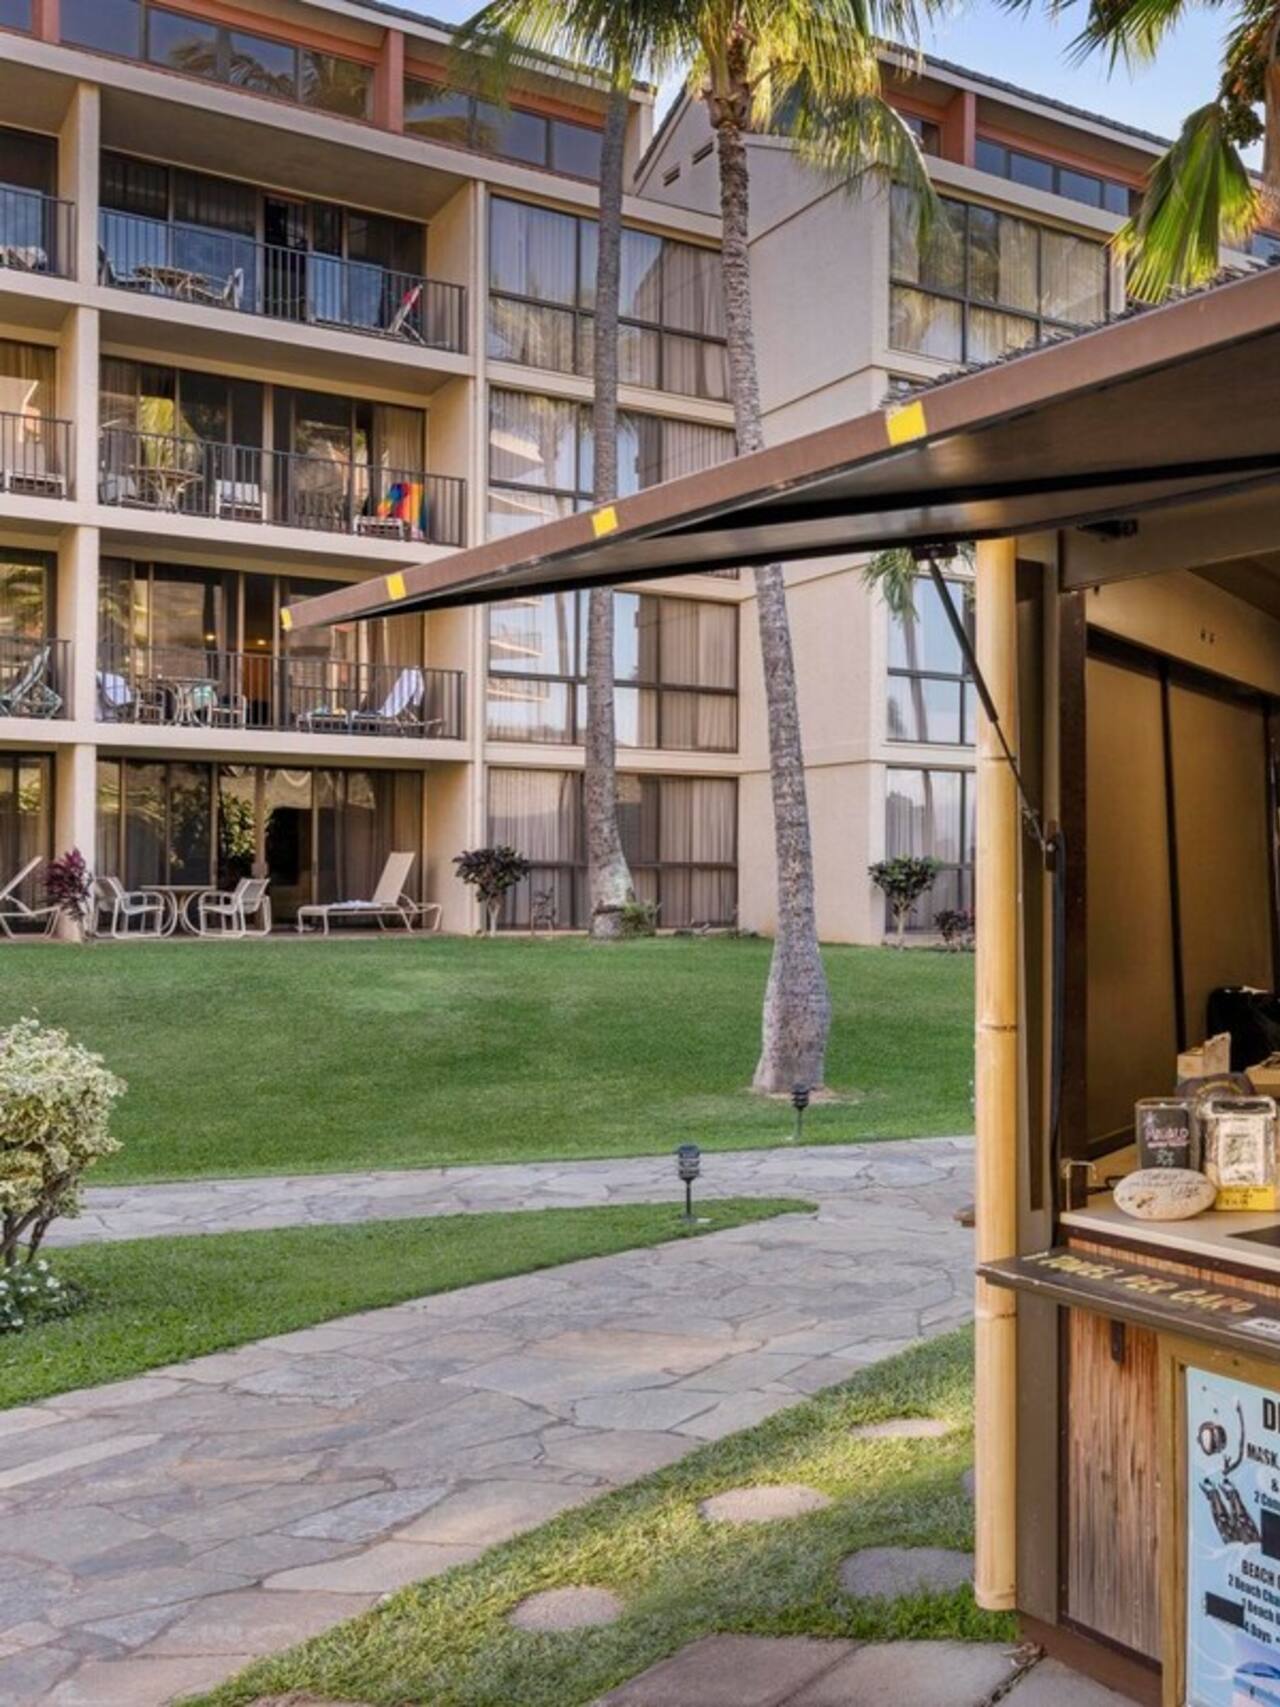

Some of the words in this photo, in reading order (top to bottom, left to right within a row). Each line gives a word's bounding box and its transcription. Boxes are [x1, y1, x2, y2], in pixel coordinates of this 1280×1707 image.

[1271, 1478, 1279, 1492] &
[1254, 1490, 1260, 1504] 2
[1242, 1559, 1275, 1587] BEACH
[1228, 1573, 1234, 1588] 2
[1235, 1576, 1261, 1599] Beach
[1248, 1599, 1274, 1623] Beach
[1250, 1622, 1273, 1644] Days
